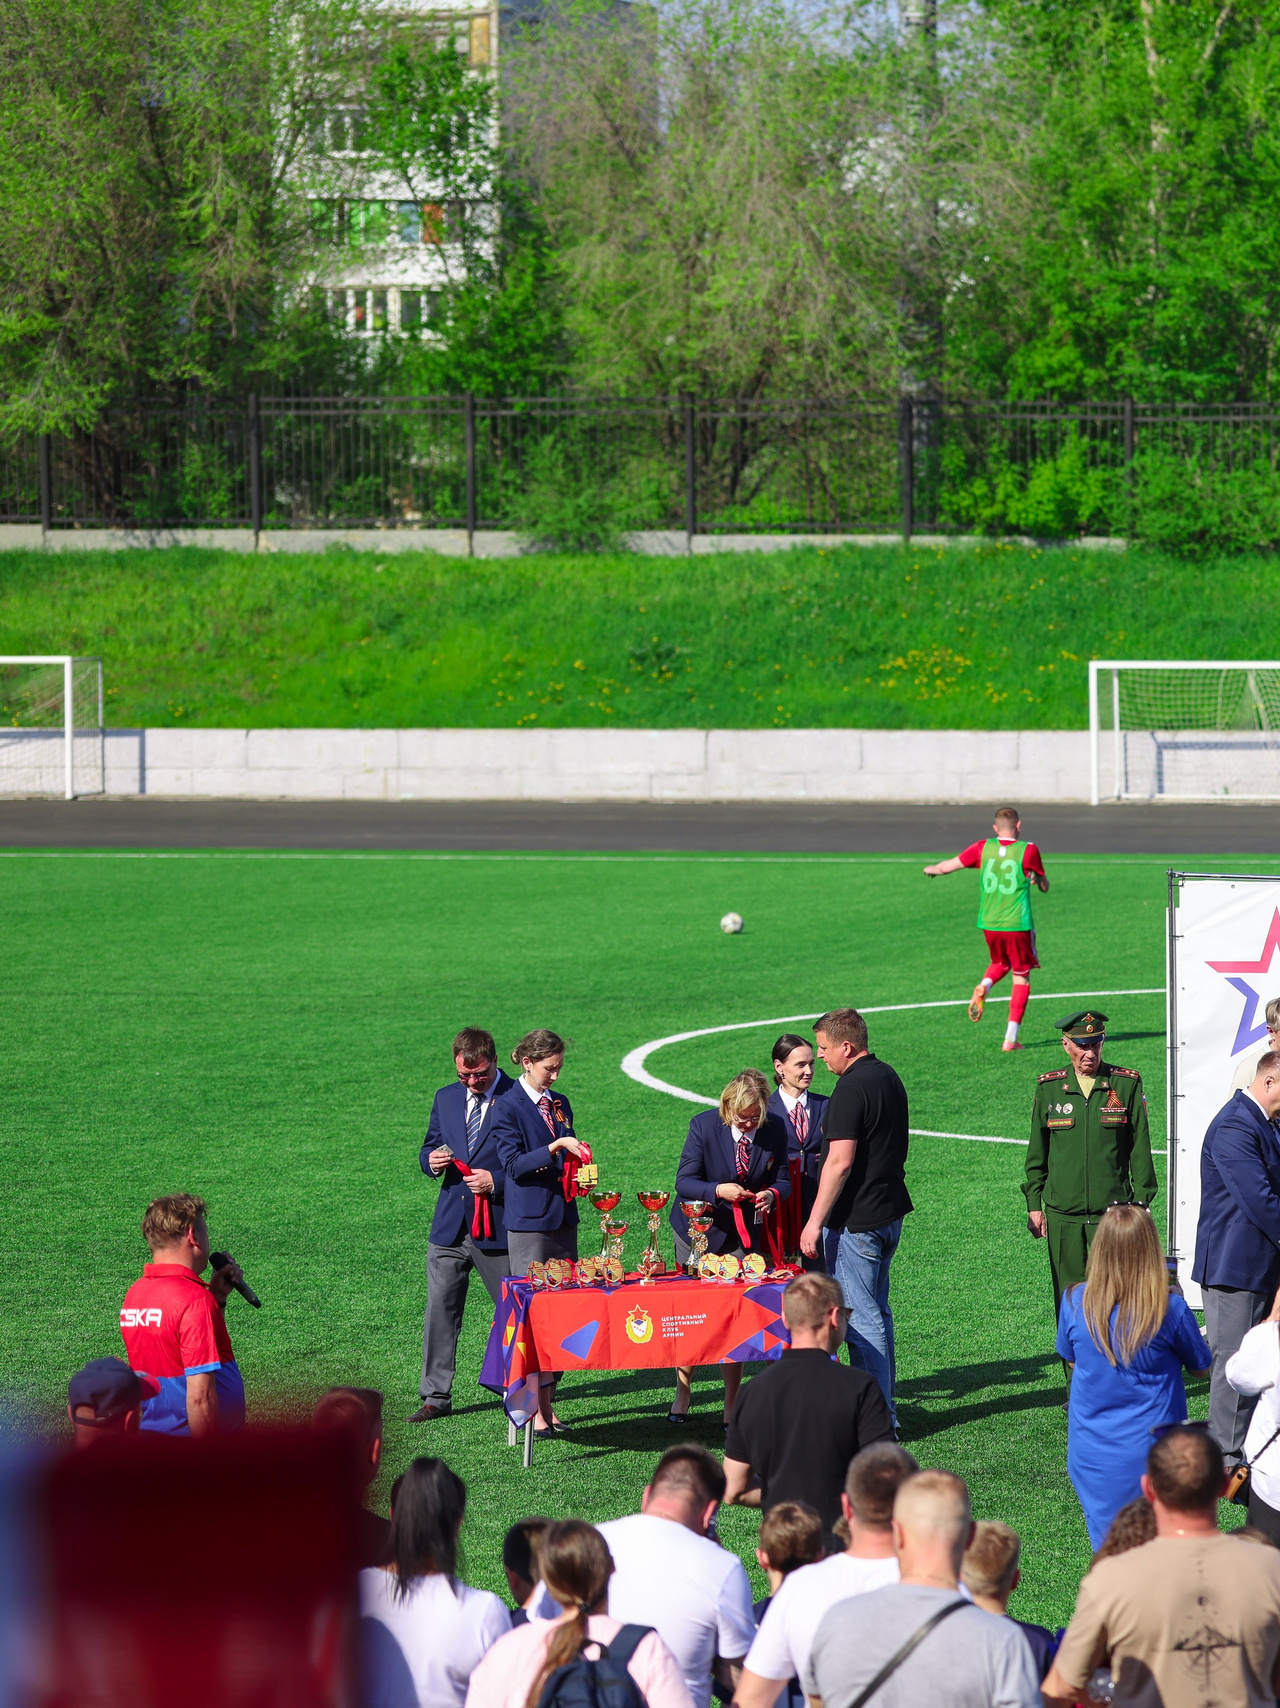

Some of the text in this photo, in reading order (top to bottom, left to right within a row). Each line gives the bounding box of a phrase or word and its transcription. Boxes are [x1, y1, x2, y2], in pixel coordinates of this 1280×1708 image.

[982, 858, 1019, 895] 63
[661, 1313, 707, 1322] ЦЕНТРАЛЬНЫЙ
[661, 1319, 704, 1328] СПОРТИВНЫЙ
